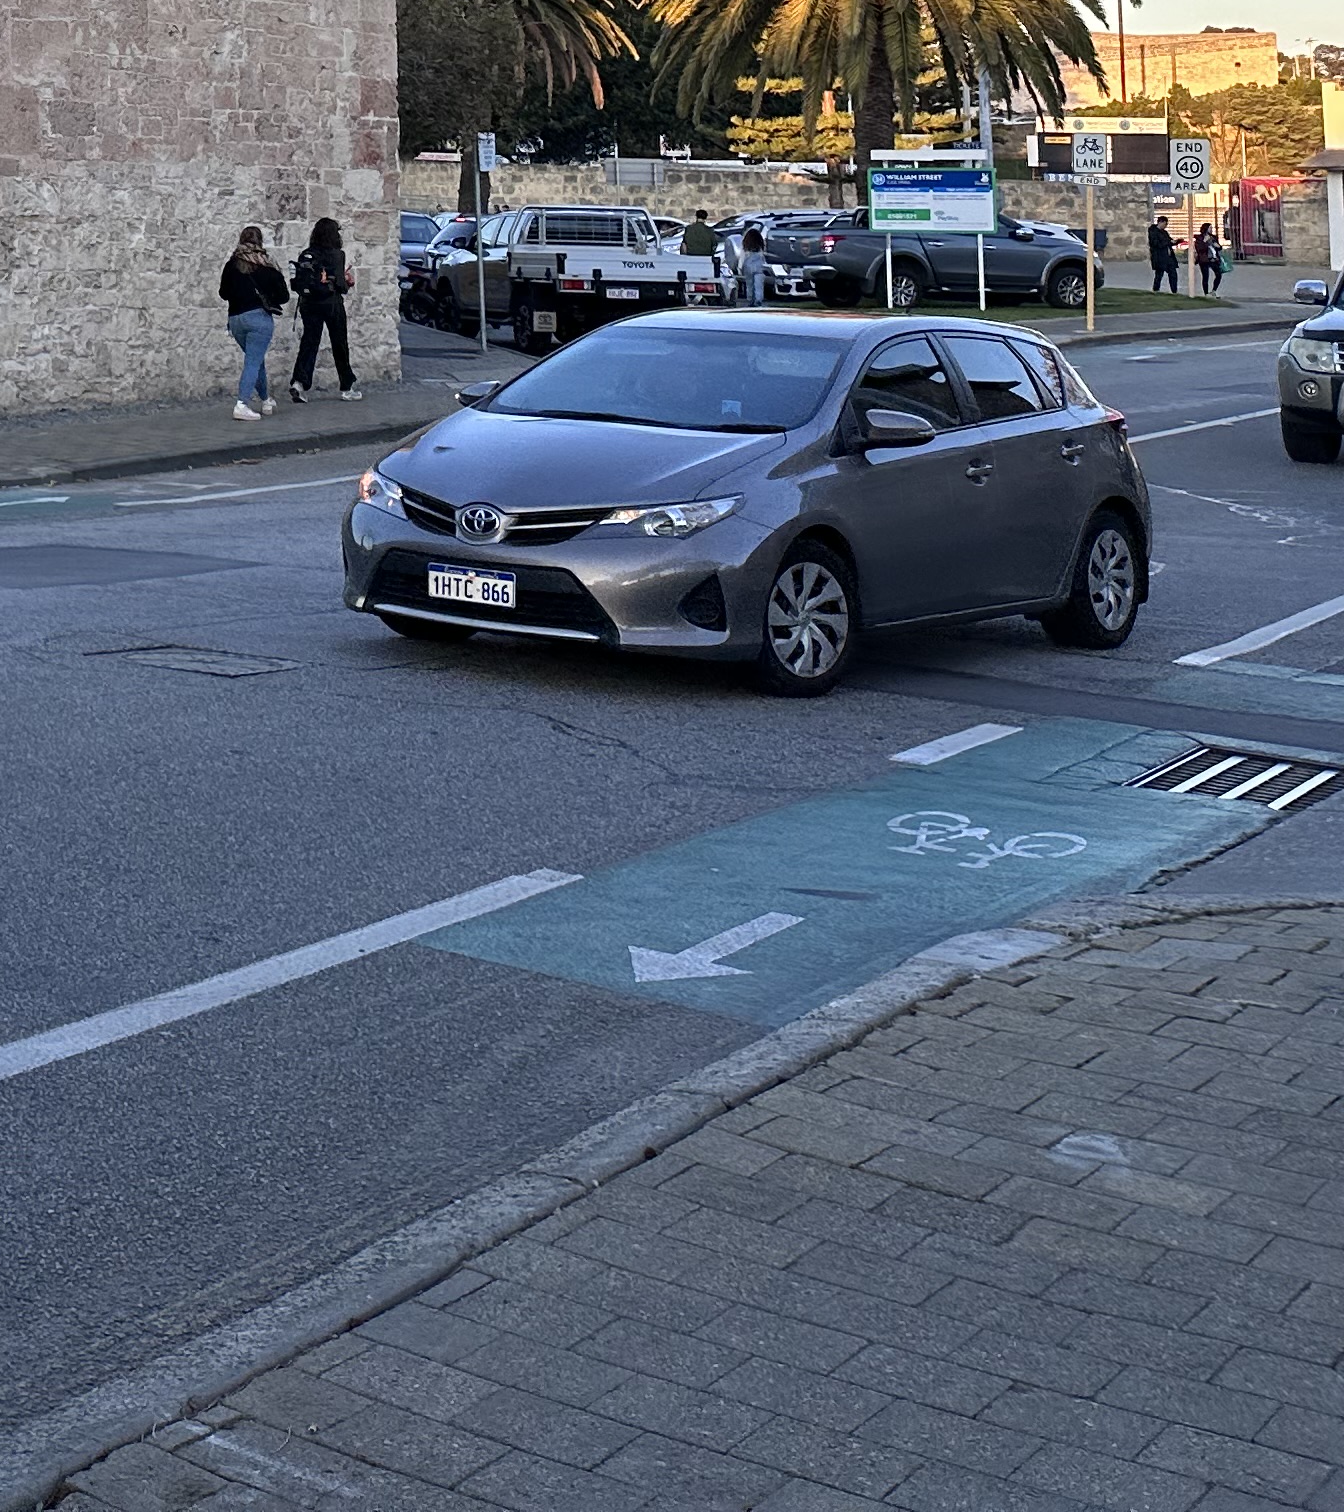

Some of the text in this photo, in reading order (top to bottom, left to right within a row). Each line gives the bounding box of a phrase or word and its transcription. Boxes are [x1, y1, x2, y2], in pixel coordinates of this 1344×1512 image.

[1176, 142, 1203, 153] END
[1075, 159, 1104, 168] LANE
[1179, 161, 1200, 174] 40
[1079, 177, 1100, 185] END
[1174, 182, 1206, 191] AREA
[621, 260, 656, 269] TOYOTA
[433, 575, 510, 604] 1HTC 866
